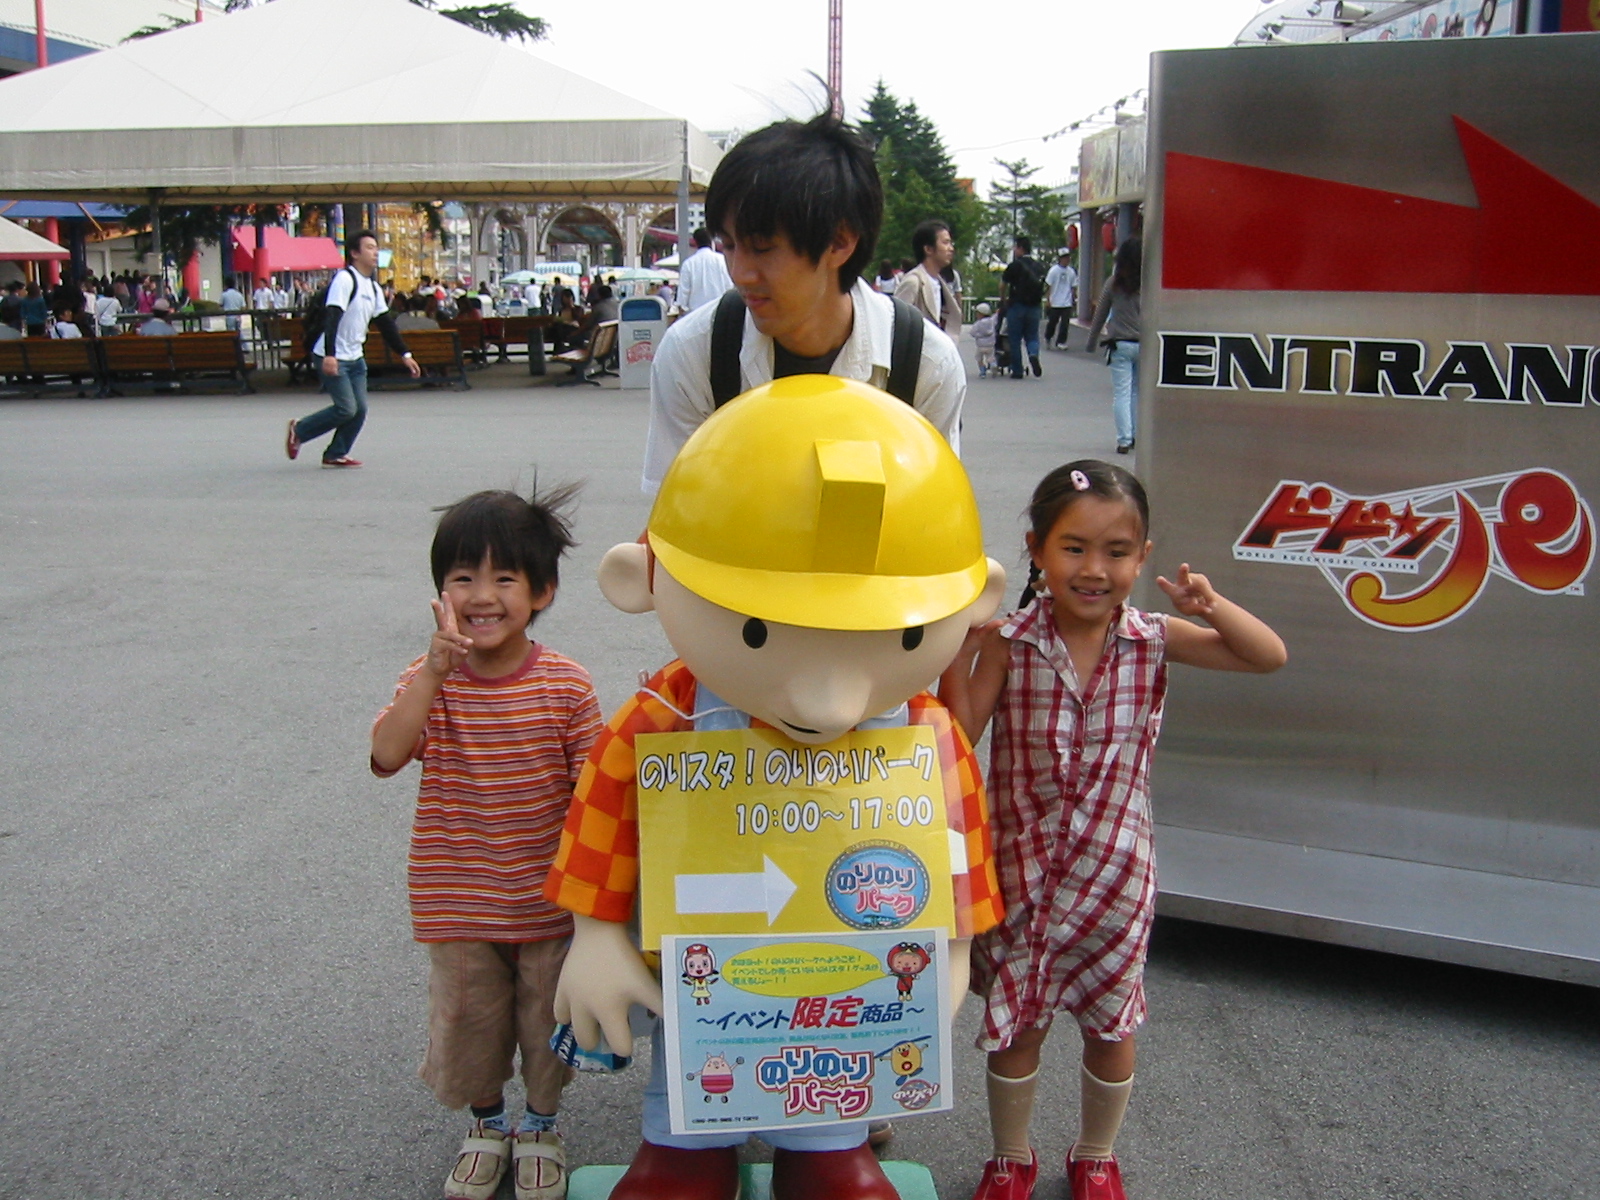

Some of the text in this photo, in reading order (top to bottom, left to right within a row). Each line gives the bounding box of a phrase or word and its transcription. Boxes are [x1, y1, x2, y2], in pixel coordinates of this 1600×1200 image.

[1157, 331, 1600, 408] ENTRAN
[1237, 551, 1275, 560] WORLD
[1362, 560, 1415, 570] COASTER
[836, 862, 916, 895] のりのり
[856, 888, 916, 918] パーク
[757, 1047, 873, 1091] のりのり
[785, 1079, 873, 1117] パーク
